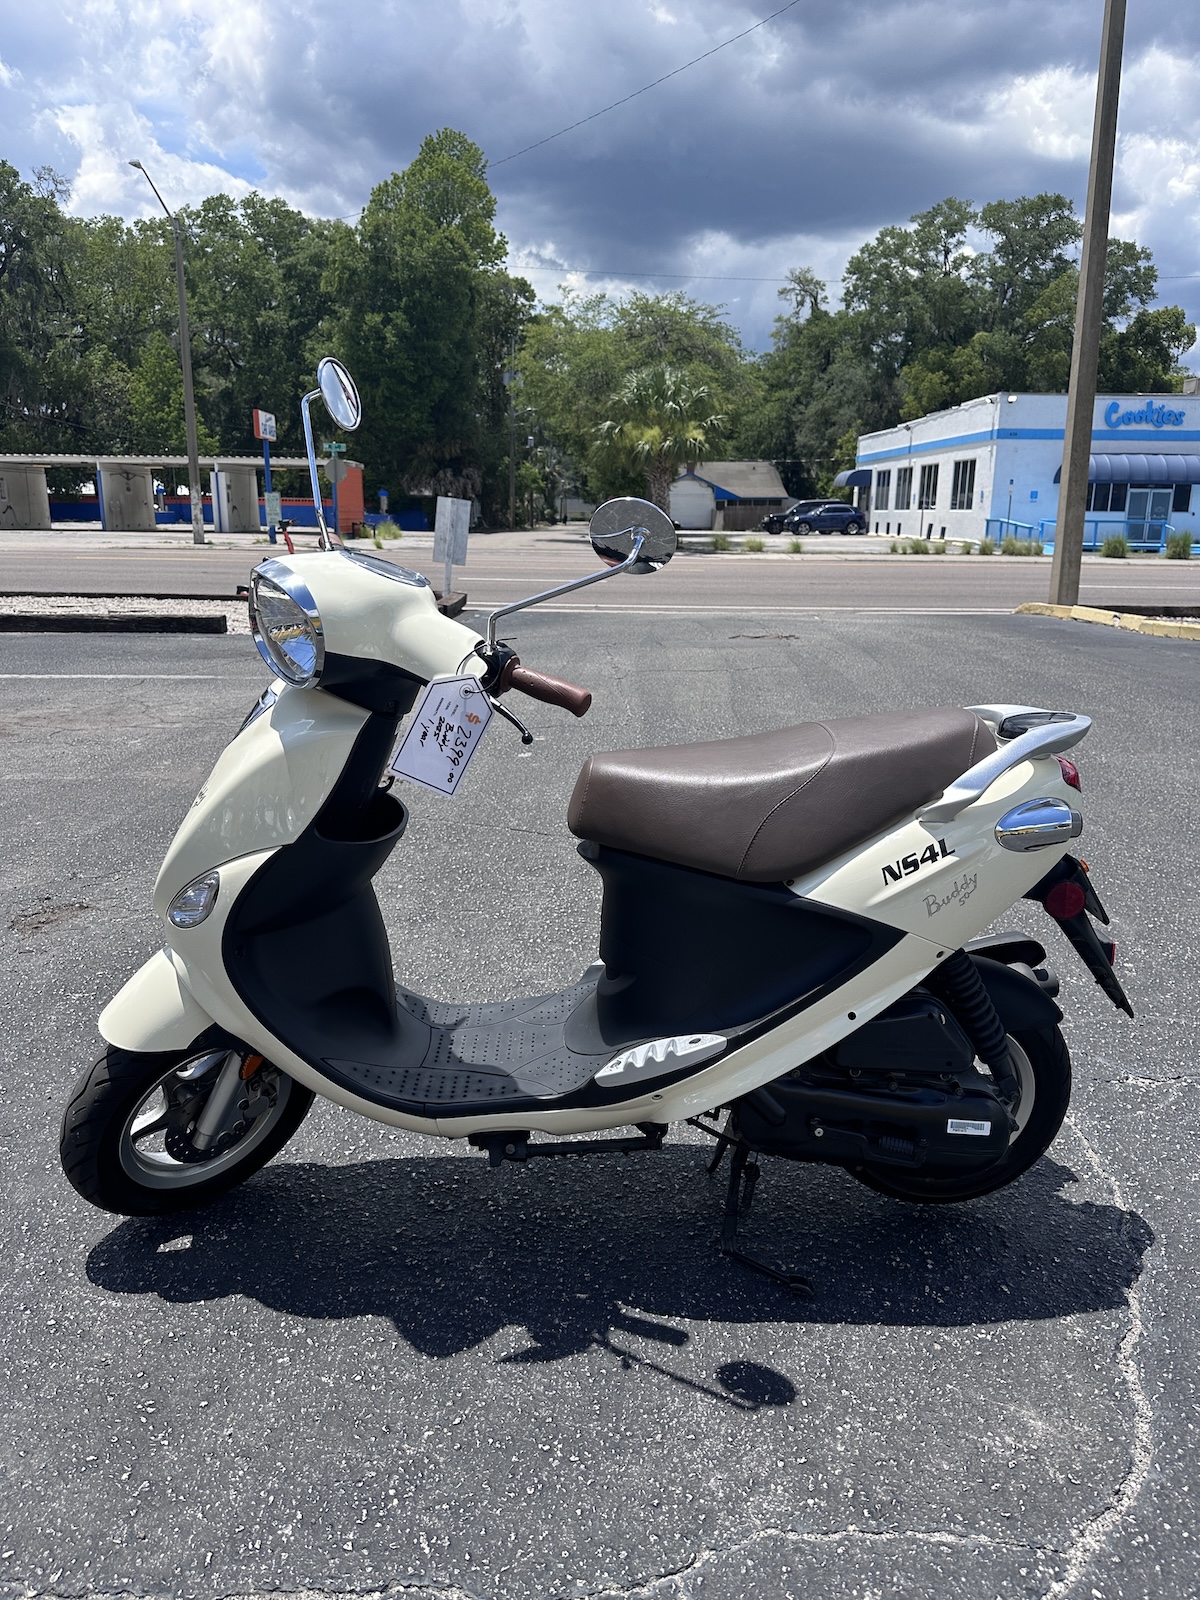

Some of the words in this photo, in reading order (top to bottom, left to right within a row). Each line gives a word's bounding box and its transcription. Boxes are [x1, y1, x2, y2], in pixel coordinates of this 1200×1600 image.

[1104, 400, 1186, 428] Cookies
[433, 716, 445, 741] 2025
[465, 712, 481, 725] $
[419, 722, 430, 747] year
[437, 722, 454, 752] Buddy
[447, 725, 472, 783] 2399.00
[881, 838, 956, 886] NS4L
[922, 873, 978, 918] Buddy
[959, 891, 970, 907] 50
